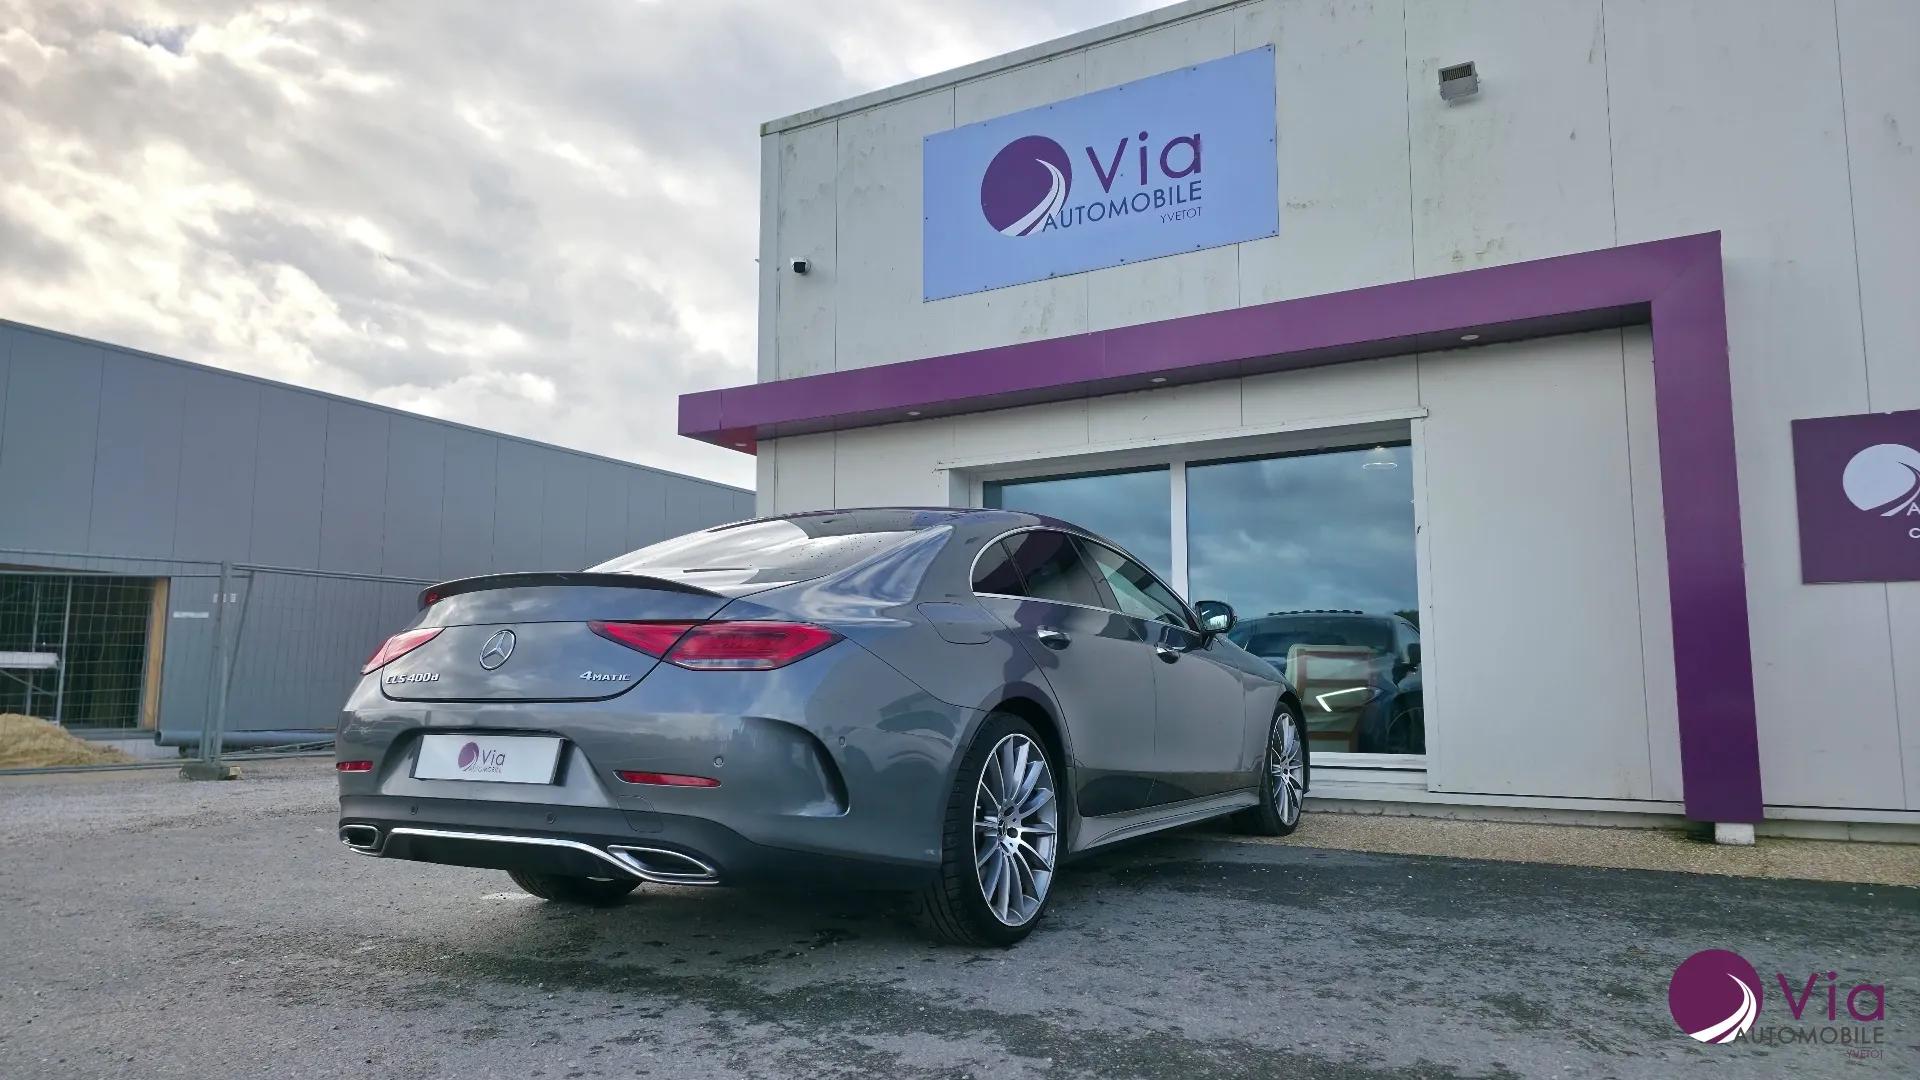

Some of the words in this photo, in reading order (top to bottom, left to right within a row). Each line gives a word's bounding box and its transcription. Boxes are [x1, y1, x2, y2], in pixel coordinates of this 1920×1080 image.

[1086, 131, 1201, 194] Via
[1042, 180, 1202, 232] AUTOMOBILE
[1160, 206, 1202, 223] YVETOT
[385, 674, 407, 684] CLS
[407, 672, 440, 682] 400d
[580, 670, 631, 681] 4MATIC
[482, 749, 506, 766] Via
